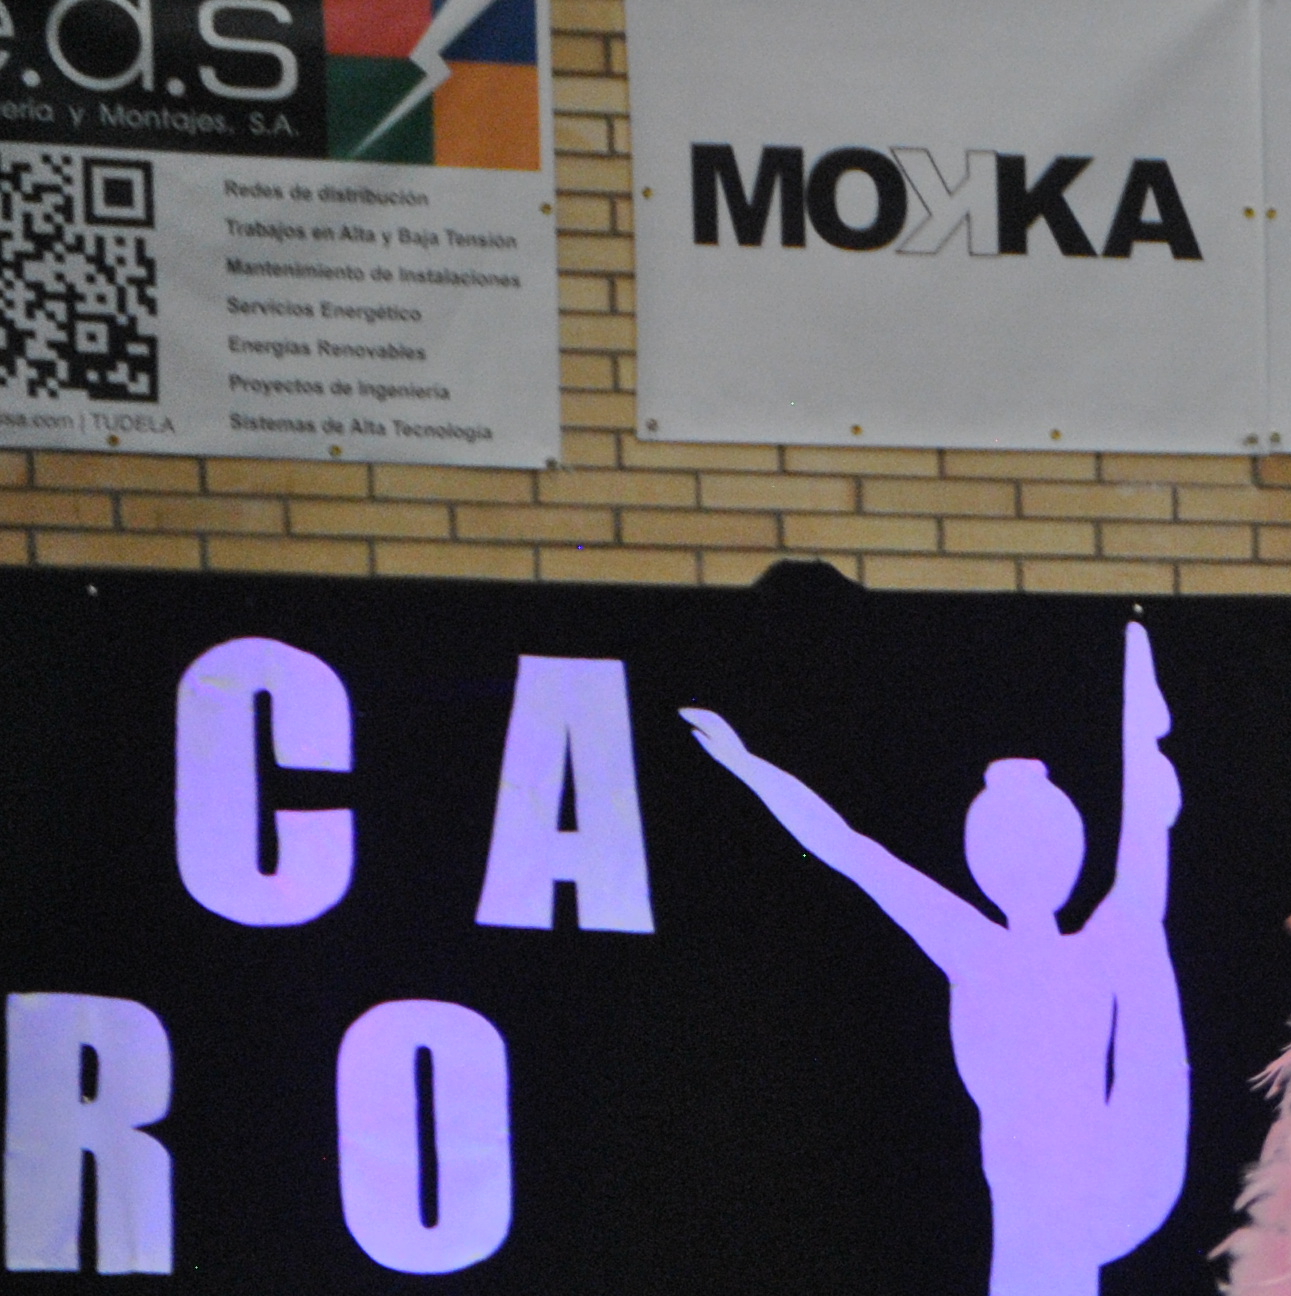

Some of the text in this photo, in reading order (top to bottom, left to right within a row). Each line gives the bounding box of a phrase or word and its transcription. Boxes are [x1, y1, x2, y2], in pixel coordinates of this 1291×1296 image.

[225, 180, 429, 207] Redes de distribución
[226, 217, 518, 250] Trabajos en Alta y Baja Tensión
[227, 257, 365, 282] Mantenimiento
[370, 264, 393, 283] de
[227, 296, 314, 318] Servicios
[316, 338, 427, 361] Renovables
[228, 373, 324, 397] Proyectos
[330, 379, 352, 396] de
[91, 412, 175, 434] TUDELA
[229, 412, 317, 434] Sistemas
[321, 417, 345, 435] de
[351, 419, 387, 437] Alta
